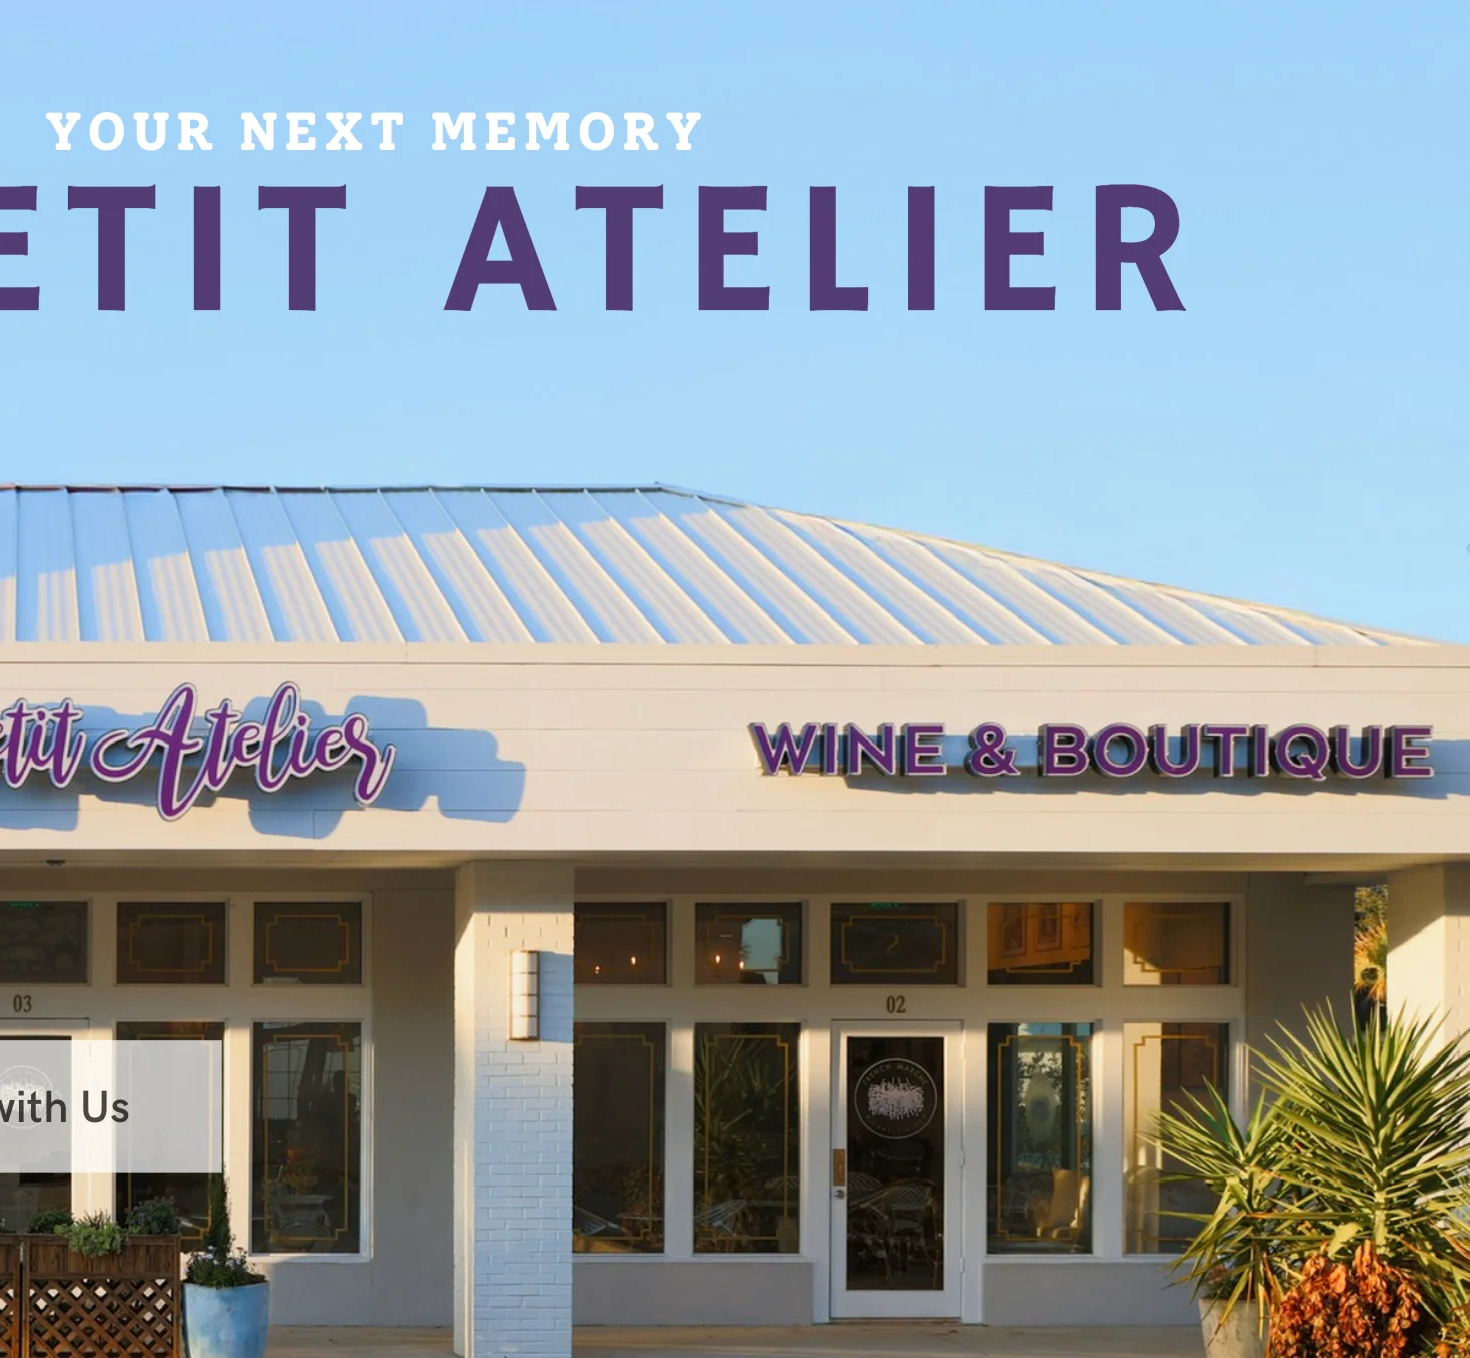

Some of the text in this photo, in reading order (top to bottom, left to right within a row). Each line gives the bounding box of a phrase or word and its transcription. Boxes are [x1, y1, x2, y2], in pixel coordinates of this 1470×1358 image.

[90, 681, 396, 821] Atelier
[749, 721, 1435, 782] WINE & BOUTIQUE
[885, 932, 901, 956] 2
[12, 994, 33, 1013] 03
[886, 995, 907, 1014] 02
